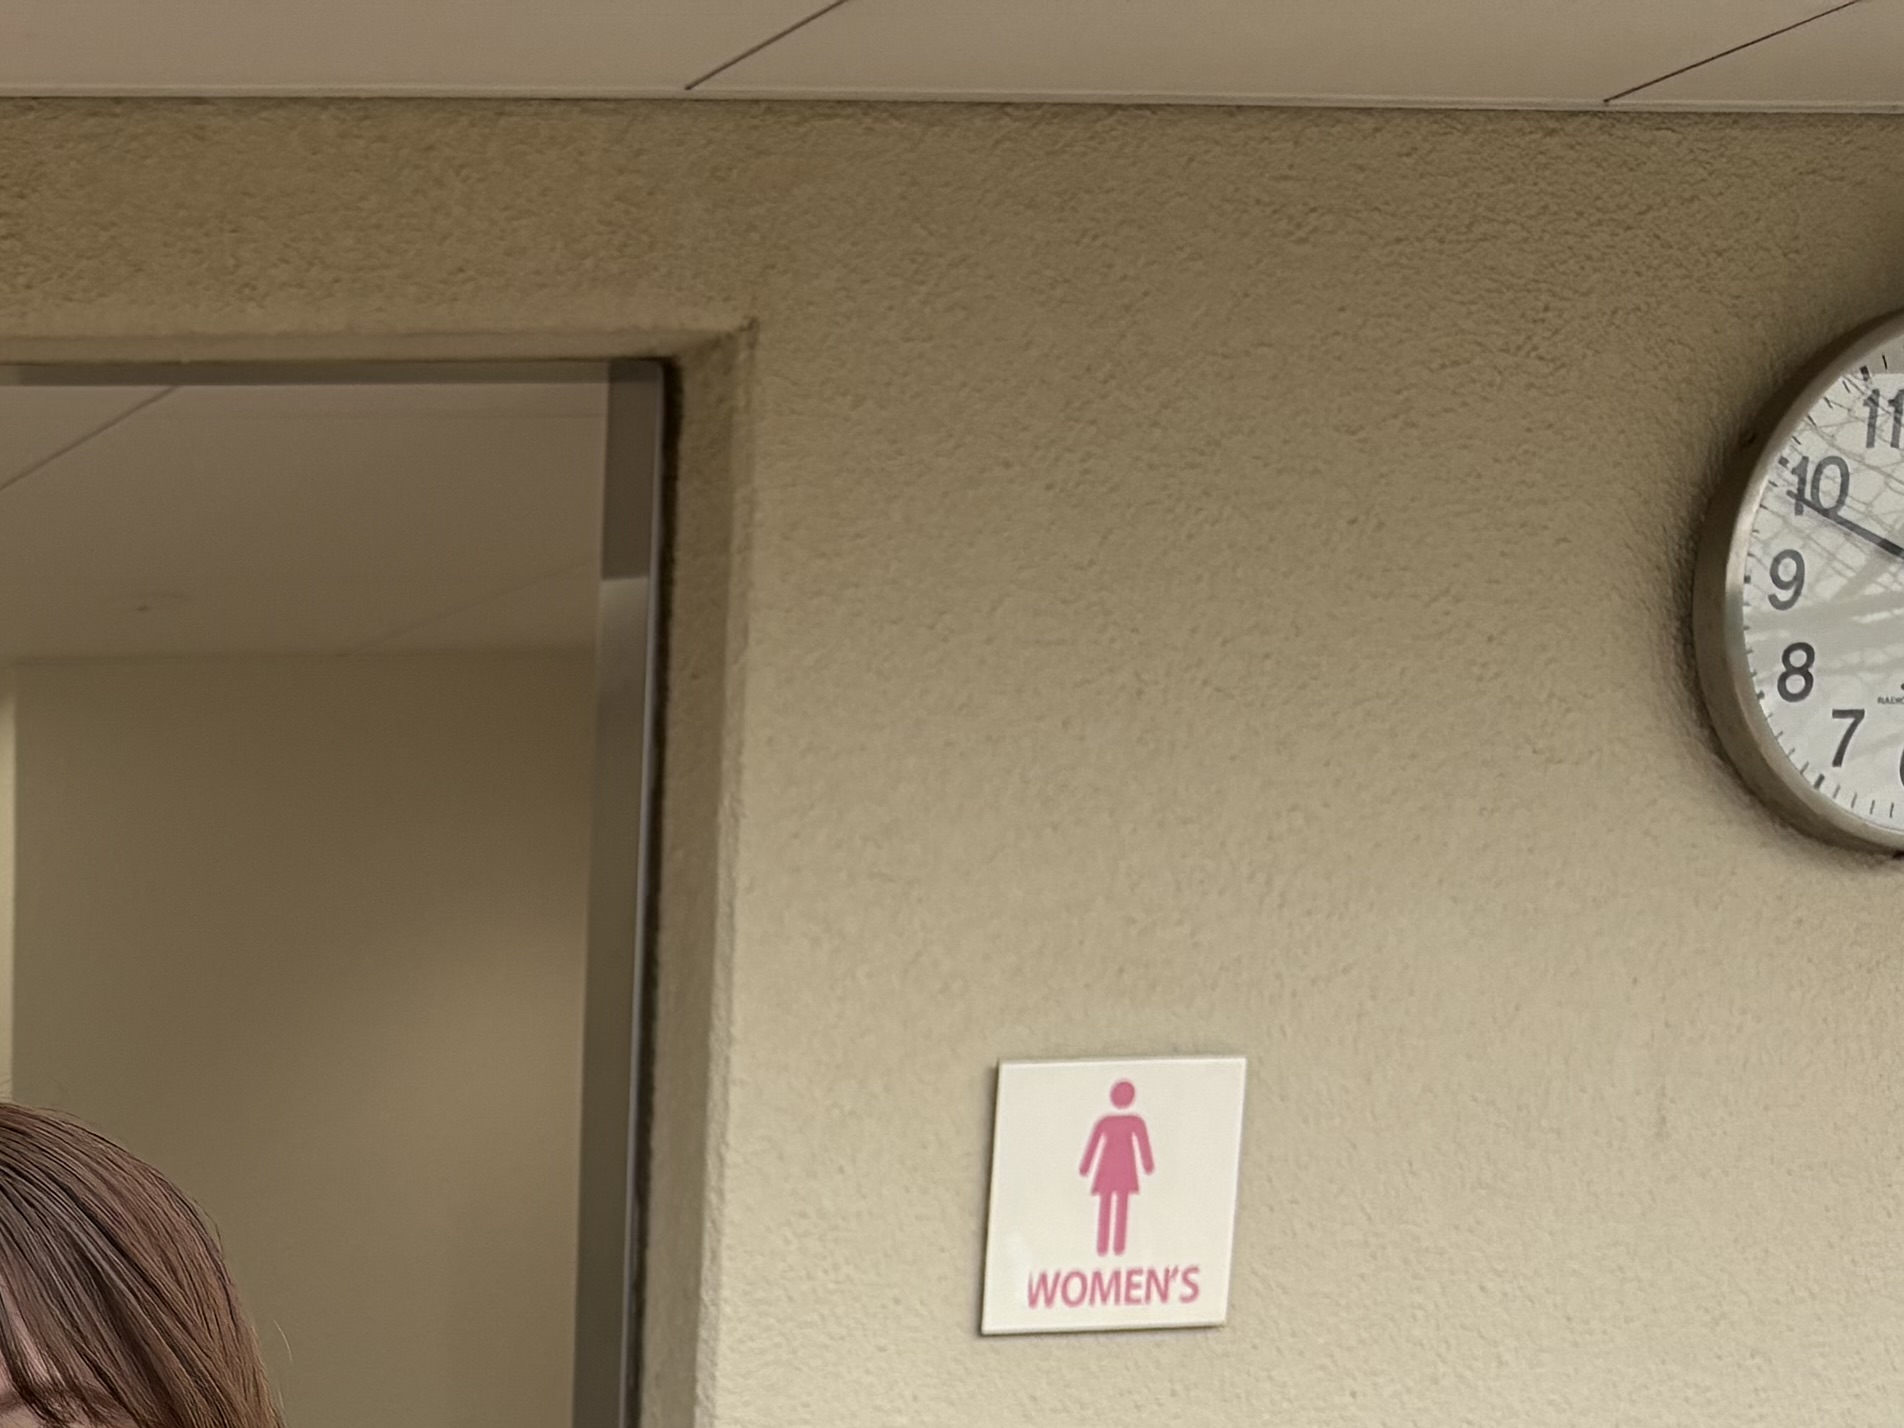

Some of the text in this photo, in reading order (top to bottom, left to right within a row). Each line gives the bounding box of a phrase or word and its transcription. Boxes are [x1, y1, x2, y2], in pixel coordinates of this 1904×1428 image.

[1787, 455, 1851, 516] 10
[1767, 549, 1806, 610] 9
[1776, 641, 1815, 702] 8
[1831, 709, 1865, 768] 7
[1026, 1264, 1201, 1310] WOMEN'S
